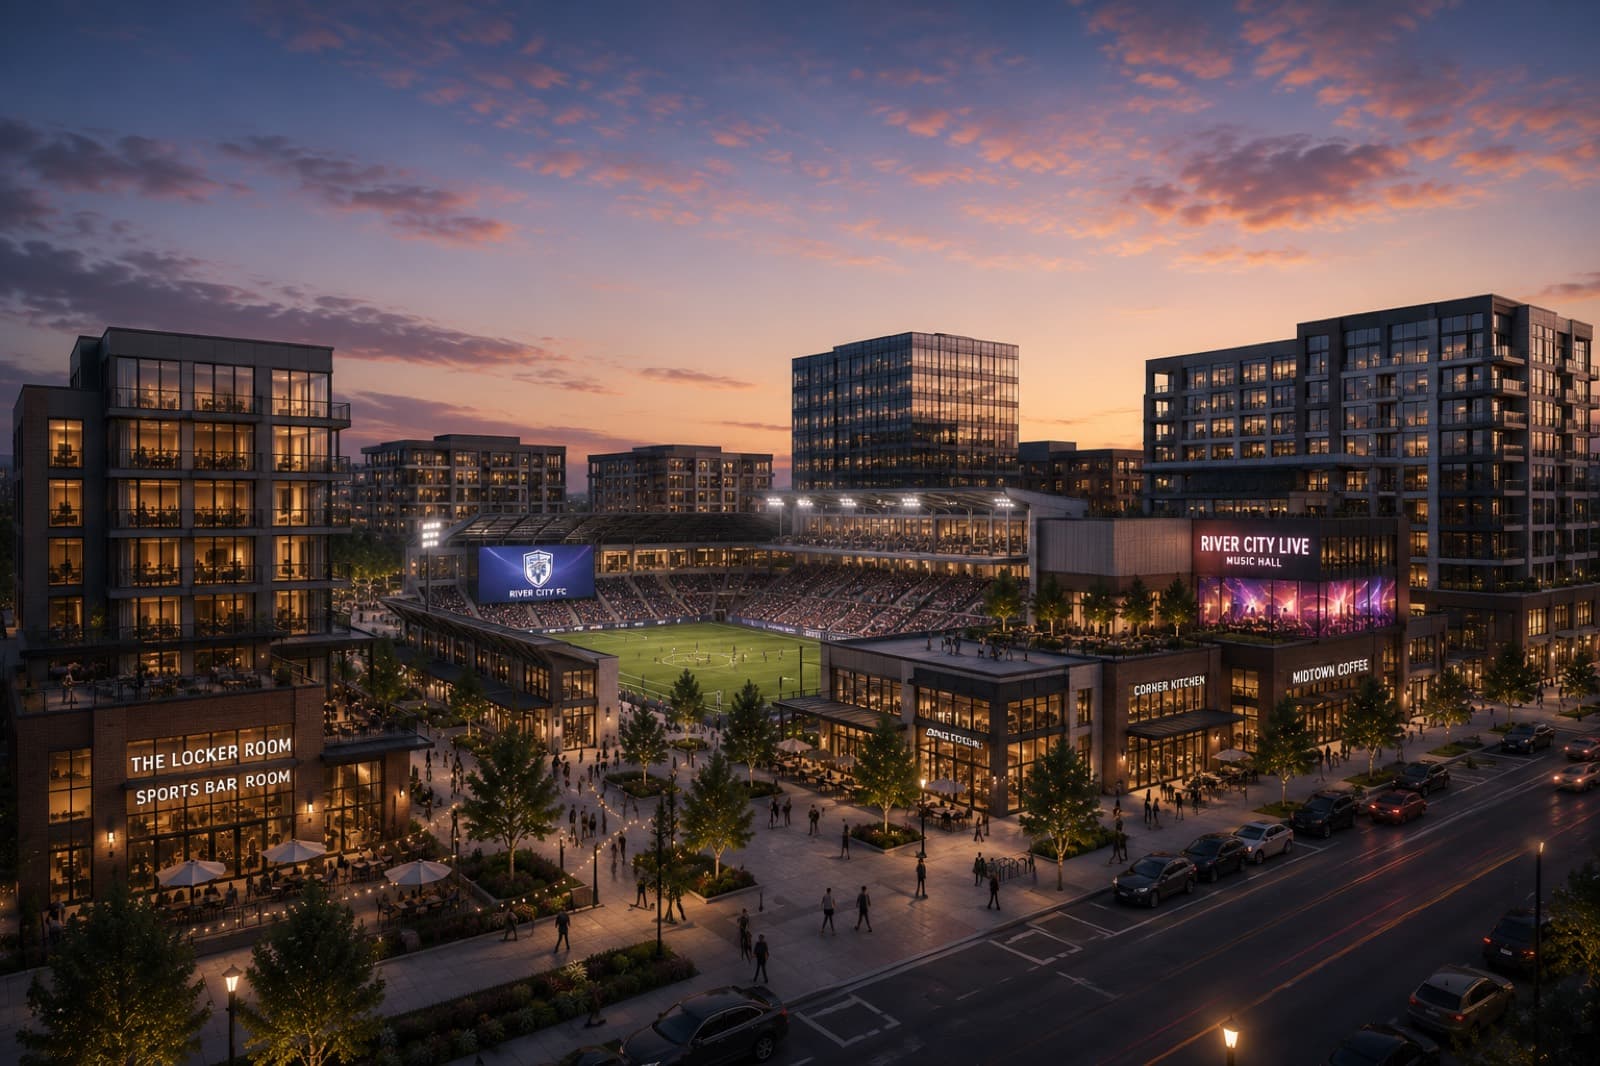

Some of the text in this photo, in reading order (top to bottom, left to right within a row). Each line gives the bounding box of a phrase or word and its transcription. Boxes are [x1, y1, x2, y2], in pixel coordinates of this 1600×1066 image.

[1201, 535, 1310, 555] RIVER CITY LIVE
[1226, 556, 1282, 568] MUSIC HALL
[509, 588, 567, 598] RIVER CITY FC
[1292, 658, 1369, 684] MIDTOWN COFFEE
[1134, 675, 1206, 696] CORNER KITCHEN
[131, 737, 292, 773] THE LOCKER ROOM
[136, 769, 291, 805] SPORTS BAR ROOM
